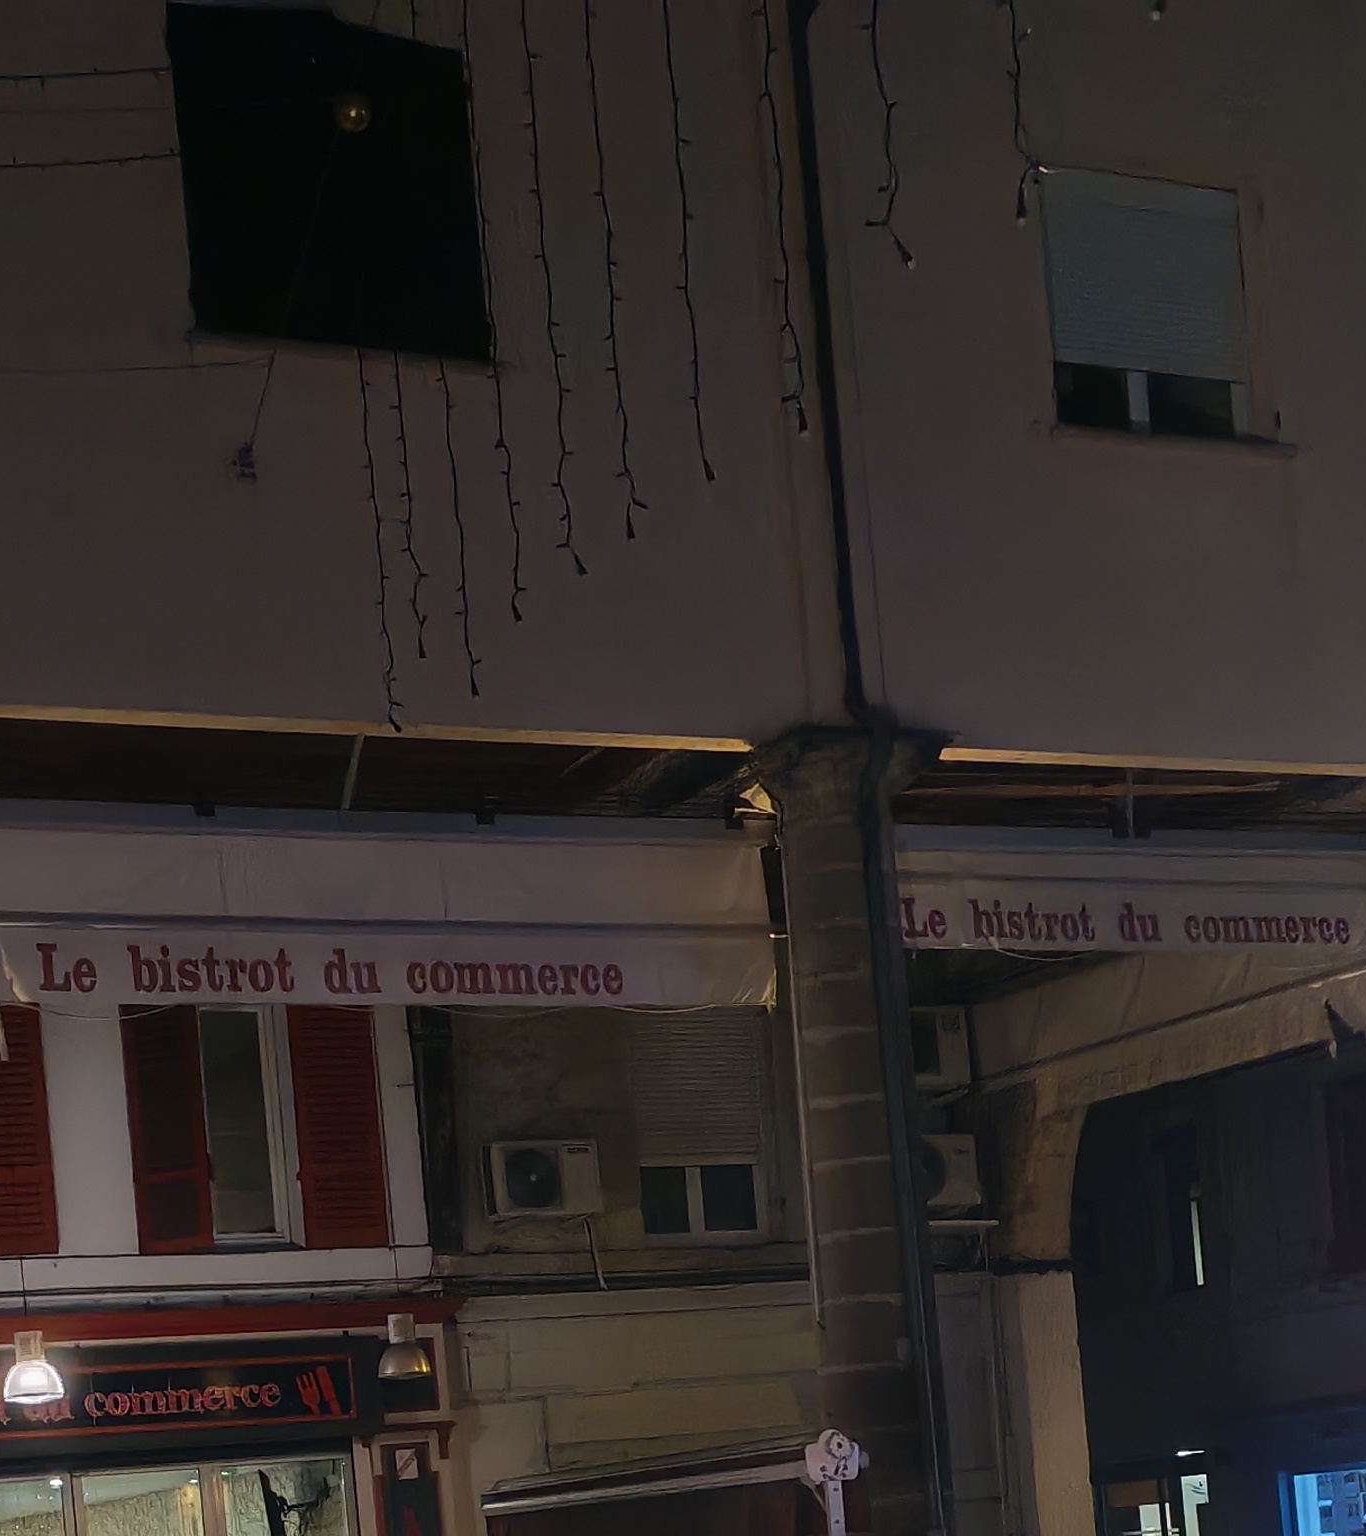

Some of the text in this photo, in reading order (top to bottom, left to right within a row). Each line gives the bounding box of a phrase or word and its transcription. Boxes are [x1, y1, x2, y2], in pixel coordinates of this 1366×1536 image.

[902, 898, 1350, 945] Le bistrot du commerce
[35, 943, 625, 997] Le bistrot du commerce
[83, 1380, 282, 1419] commerce
